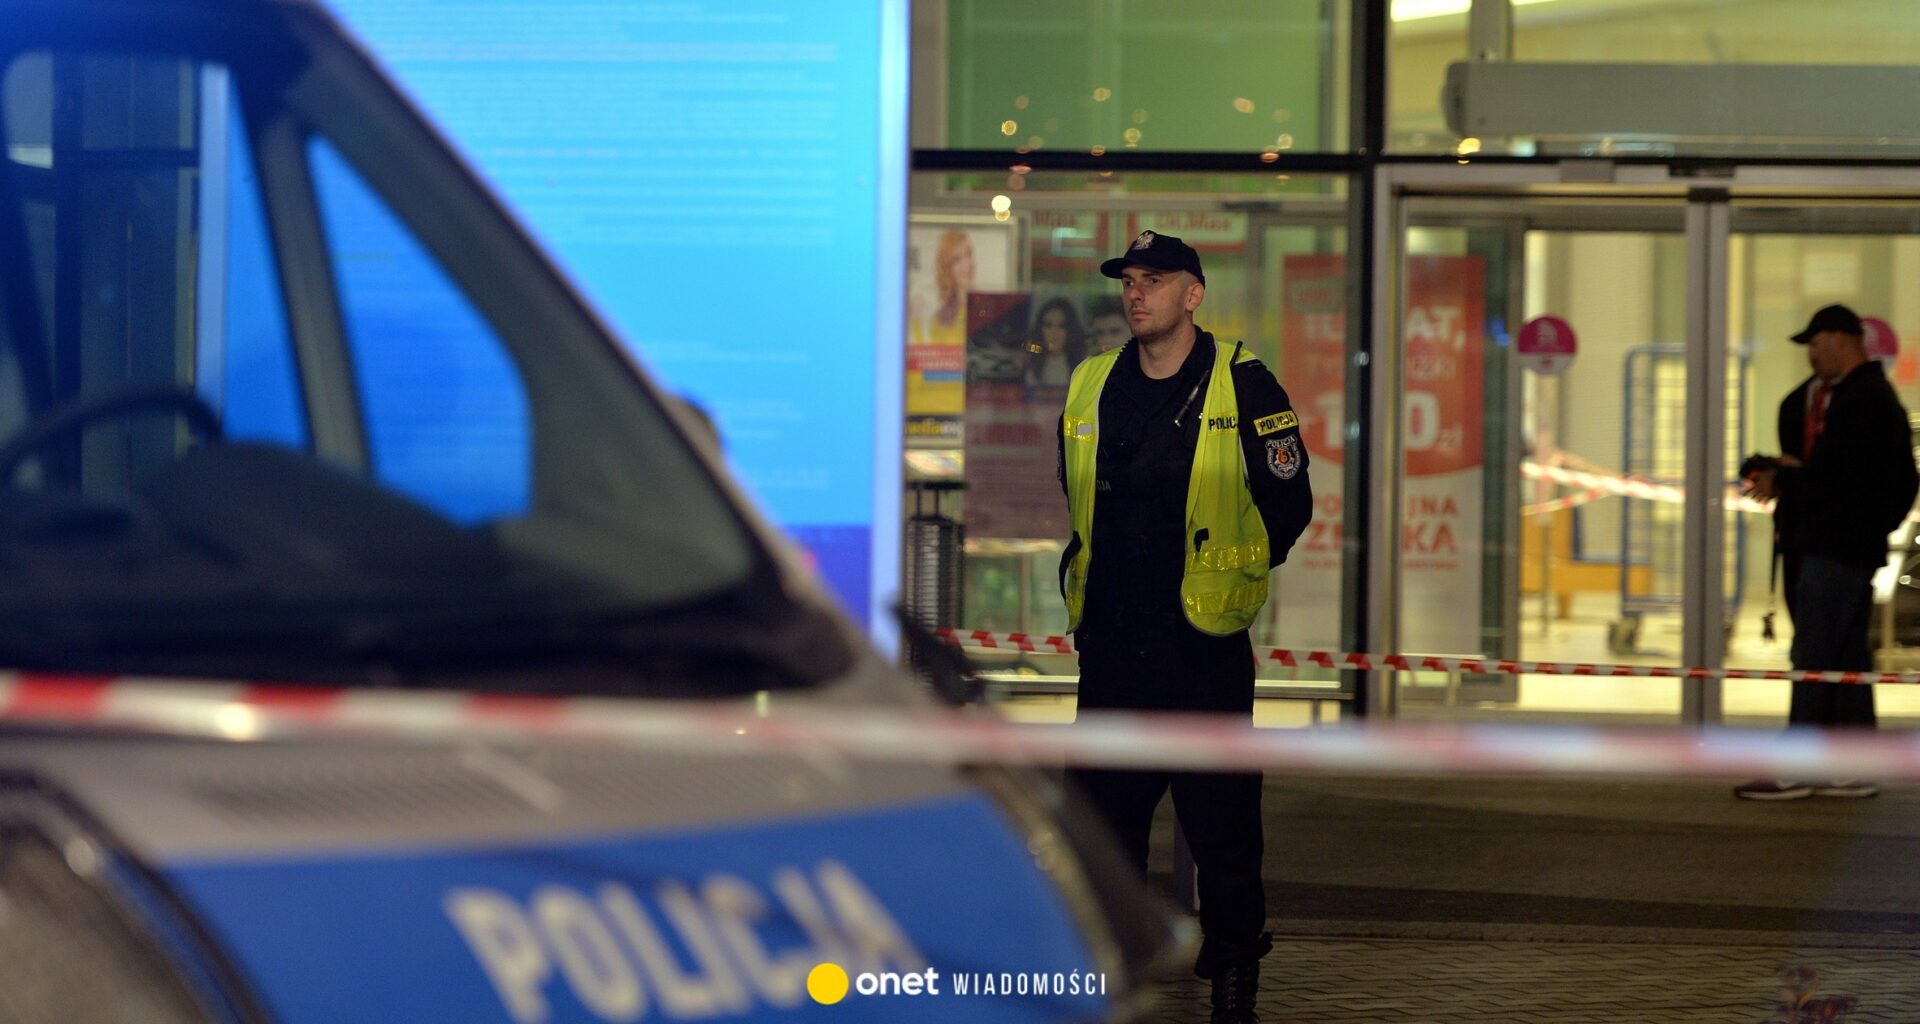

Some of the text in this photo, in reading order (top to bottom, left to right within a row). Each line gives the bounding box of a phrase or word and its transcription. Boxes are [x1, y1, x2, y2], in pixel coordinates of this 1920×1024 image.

[1208, 416, 1239, 431] POLIC
[1260, 414, 1294, 431] POLICJA
[1267, 436, 1296, 448] POLICJA
[447, 862, 926, 1024] POLICJA
